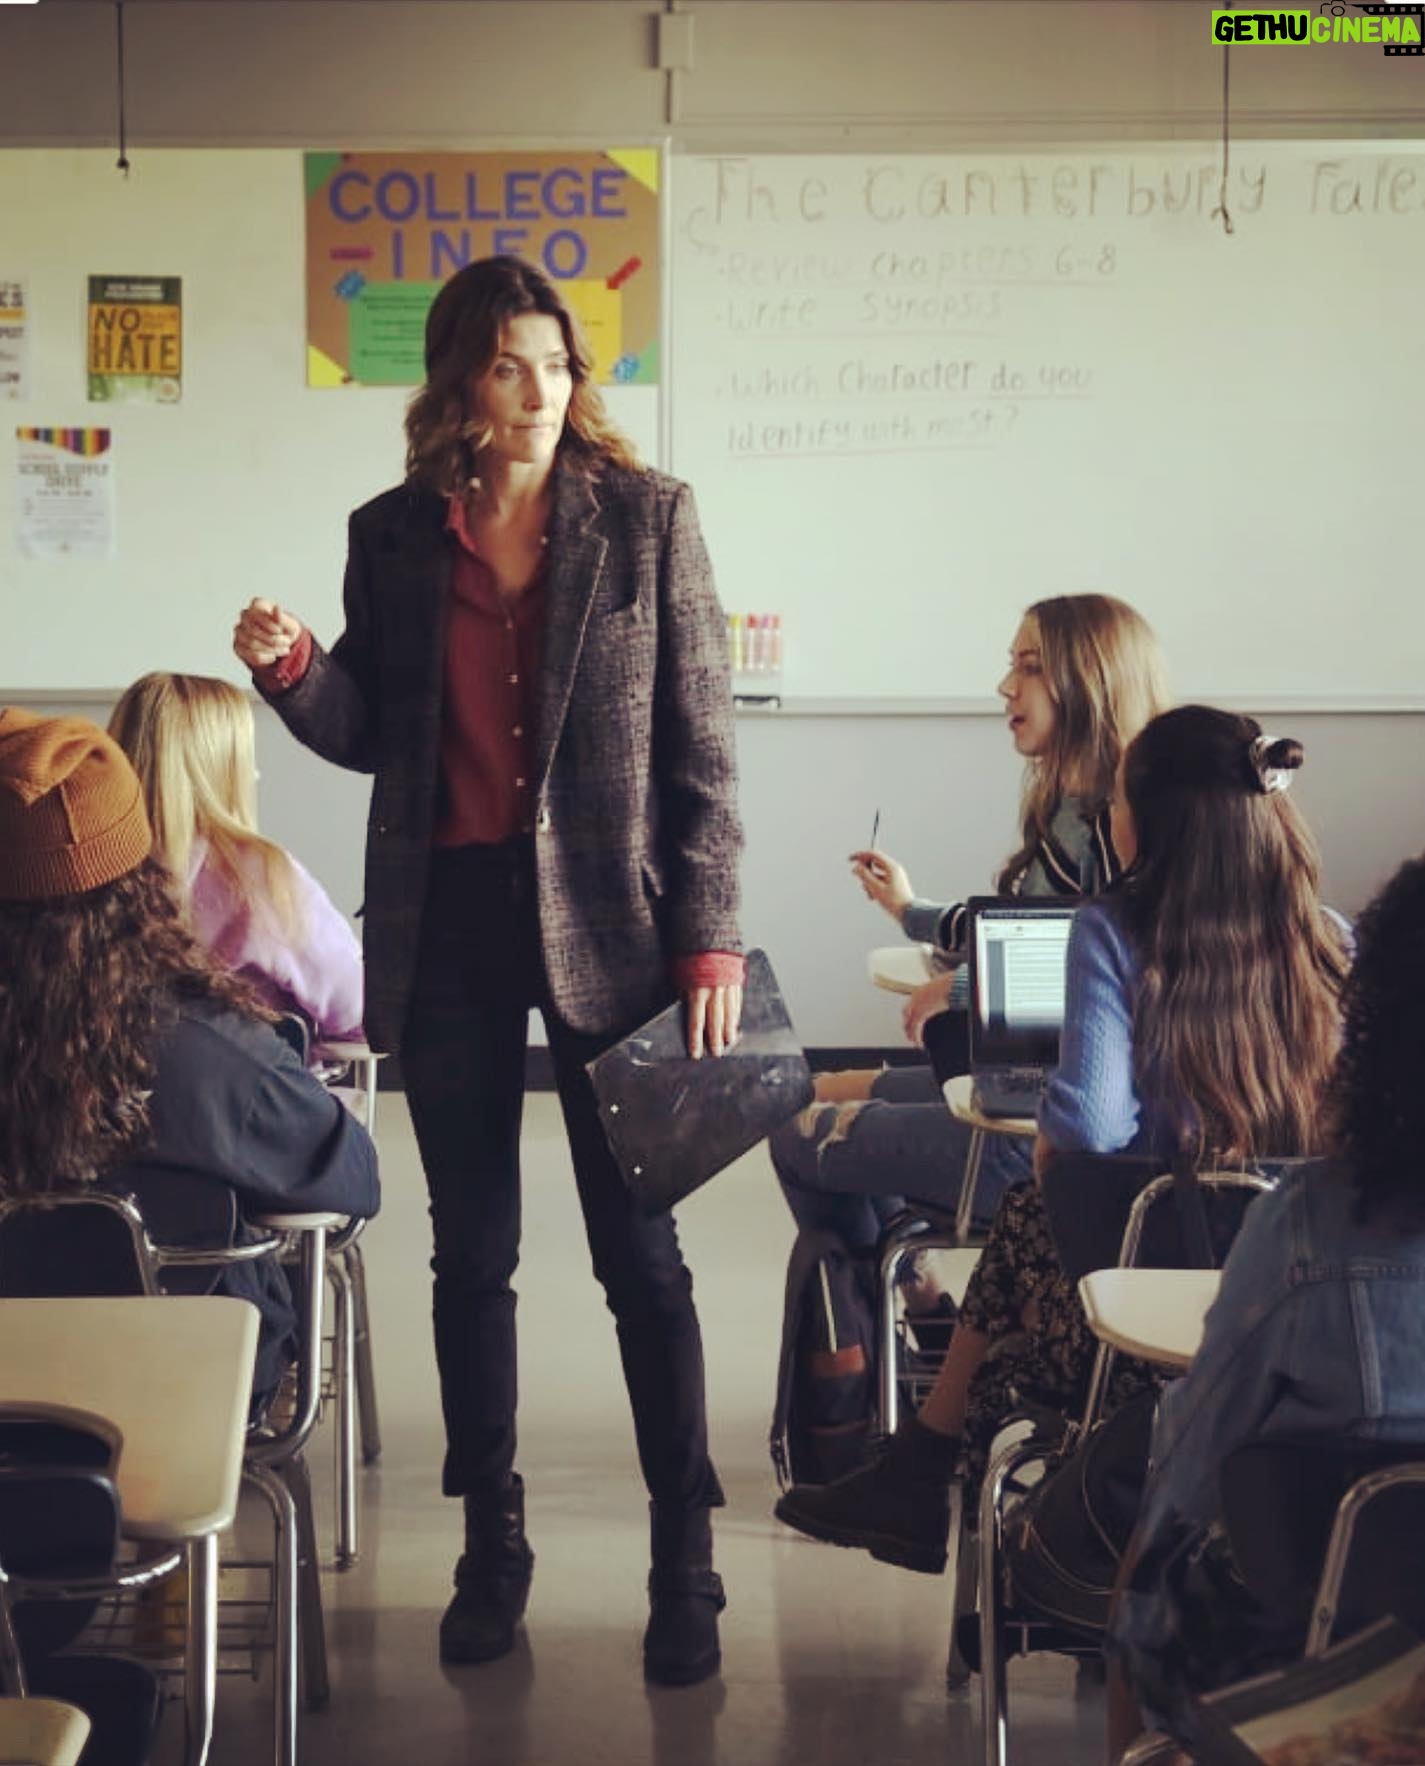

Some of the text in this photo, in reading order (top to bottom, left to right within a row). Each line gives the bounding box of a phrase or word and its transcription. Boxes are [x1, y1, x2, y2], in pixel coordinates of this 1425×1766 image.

[329, 167, 628, 223] COLLEGE
[697, 156, 1425, 224] The Canterbury Tale
[1055, 243, 1117, 276] 6-8
[94, 307, 141, 333] NO
[93, 334, 179, 370] HATE
[990, 361, 1026, 391] do
[1038, 364, 1094, 397] you
[862, 412, 916, 440] with
